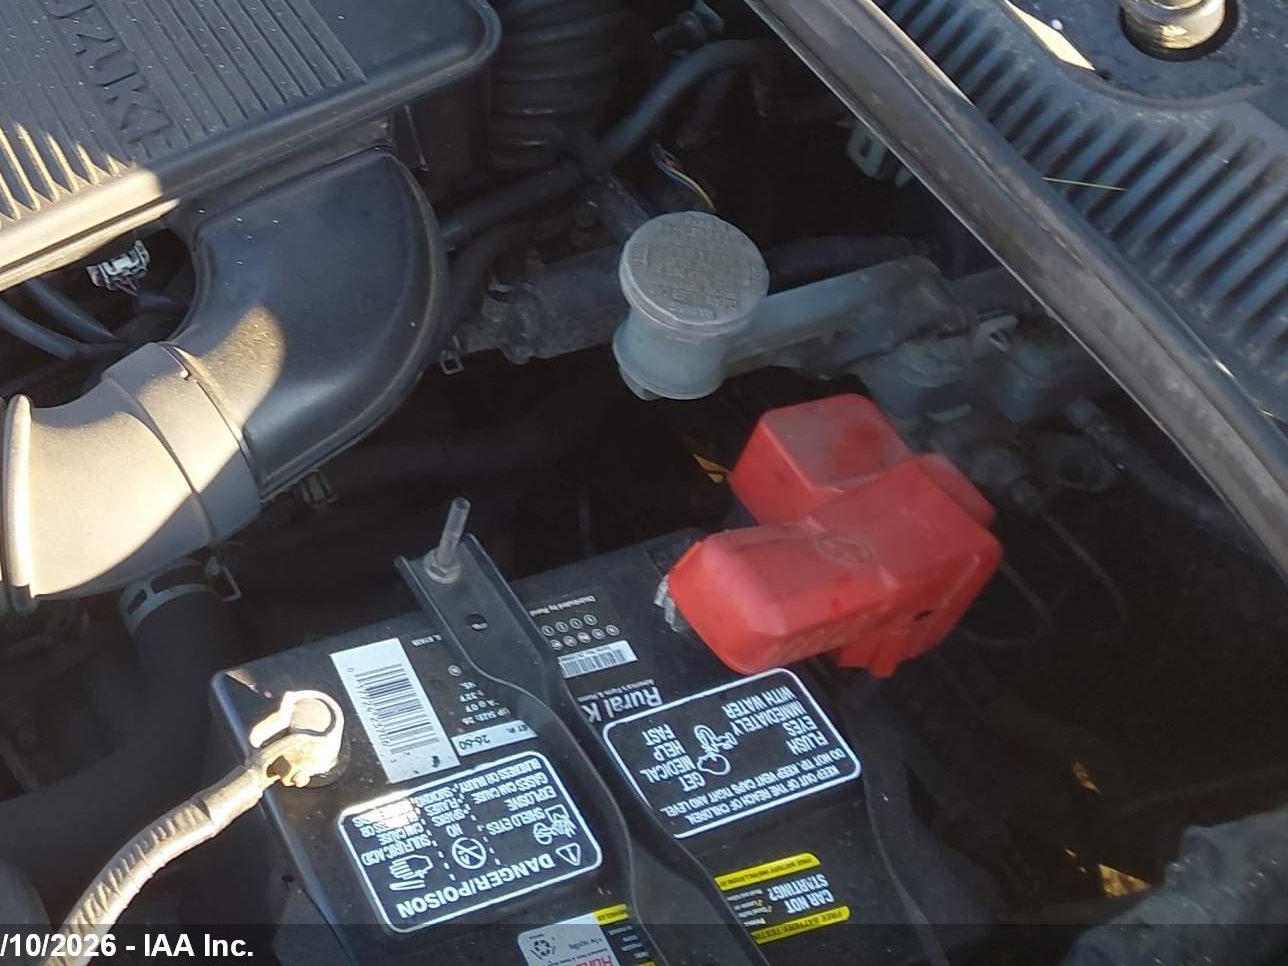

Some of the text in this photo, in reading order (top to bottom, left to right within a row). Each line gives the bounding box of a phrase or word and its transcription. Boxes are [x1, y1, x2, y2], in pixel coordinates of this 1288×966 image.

[603, 686, 662, 717] Rural
[721, 685, 796, 719] WITH WATER
[729, 700, 807, 736] IMMEDIATELY
[782, 715, 818, 736] EYES
[458, 734, 491, 750] 26-60
[641, 723, 676, 746] FAST
[785, 730, 829, 755] FLUSH
[653, 739, 686, 761] HELP
[455, 758, 541, 793] BLINDNESS OR INJURY
[639, 754, 696, 783] MEDICAL
[470, 771, 548, 804] GASES CAN CAUSE
[659, 748, 846, 817] DO NOT TIP. KEEP VENT CAPS TIGHT AND LEVEL.
[678, 771, 706, 792] GET
[423, 797, 459, 816] FLAMES
[503, 785, 557, 811] EXPLOSIVE
[684, 765, 840, 824] KEEP OUT OF THE REACH OF CHILDREN.
[431, 808, 465, 827] SPARKS
[445, 823, 463, 837] NO
[485, 806, 546, 835] SHIELD EYES
[359, 825, 375, 837] OR
[376, 822, 424, 845] CAN CAUSE
[360, 833, 431, 866] SULFURIC ACID
[396, 853, 555, 918] DANGER/POISON
[767, 873, 828, 901] STARTING?
[806, 889, 834, 906] CAR
[783, 895, 810, 913] NOT
